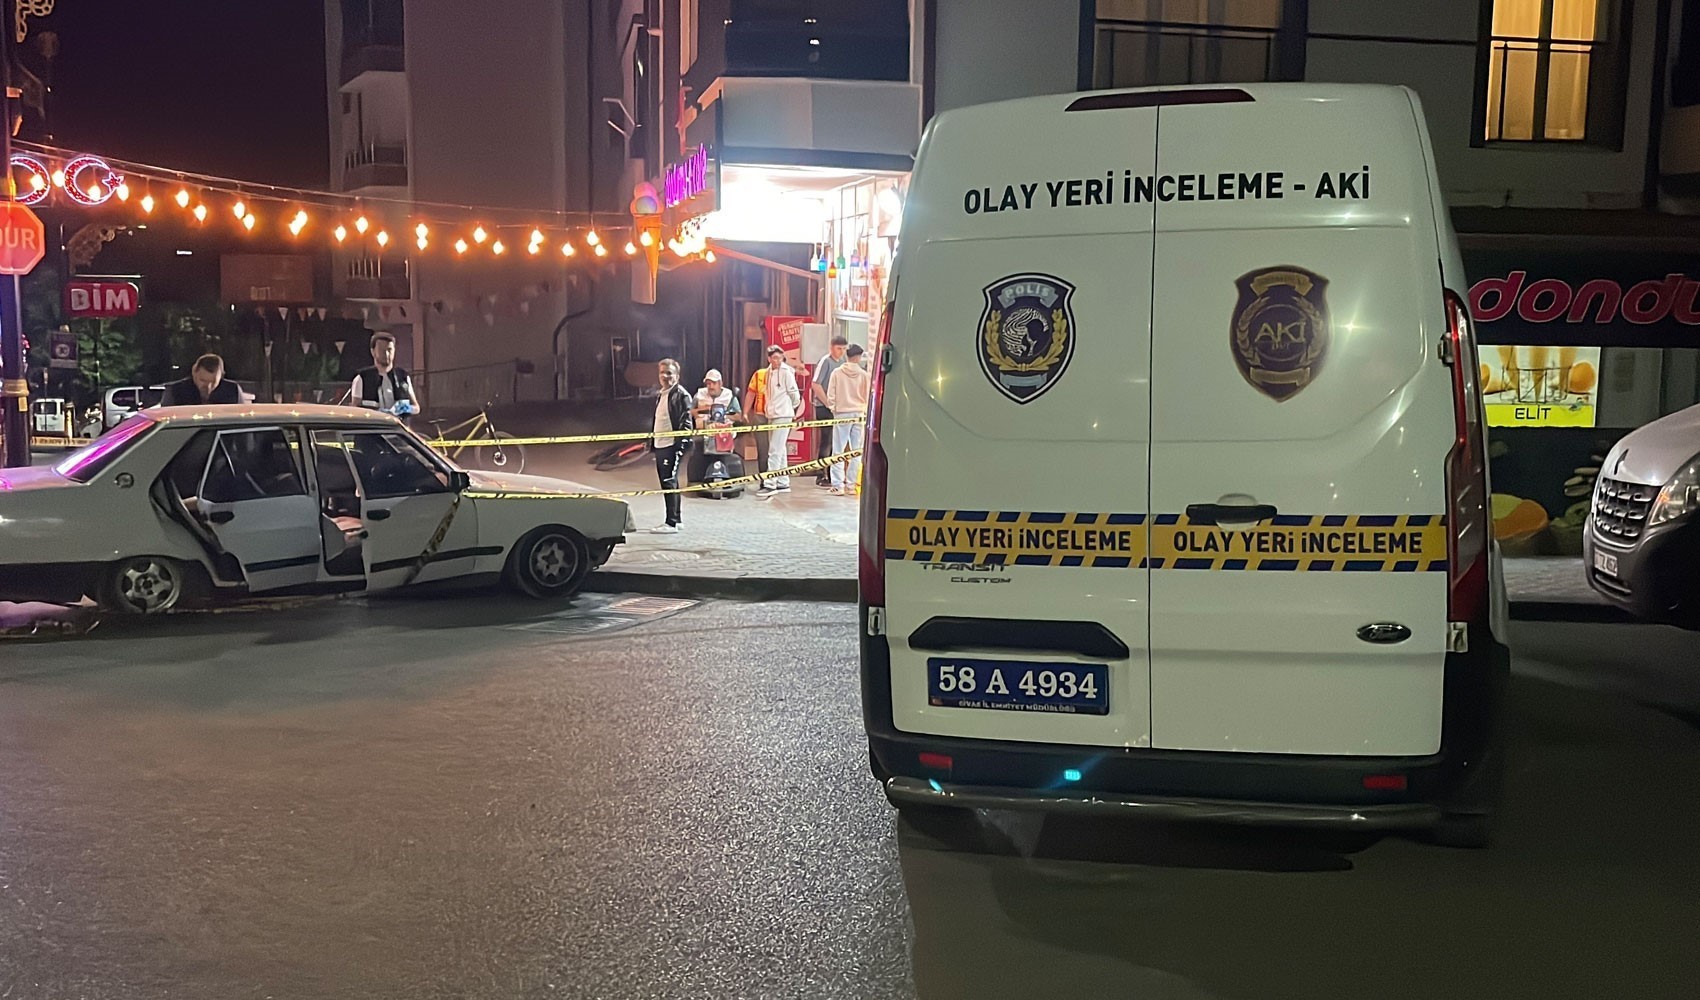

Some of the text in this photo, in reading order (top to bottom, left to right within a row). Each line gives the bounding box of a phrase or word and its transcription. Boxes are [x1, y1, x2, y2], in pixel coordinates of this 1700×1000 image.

[963, 182, 1038, 215] OLAY
[1046, 170, 1114, 208] YERİ
[1123, 169, 1284, 204] İNCELEME
[1314, 165, 1370, 199] AKİ
[0, 227, 36, 250] UR
[71, 283, 130, 311] BİM
[1005, 284, 1050, 299] POLİS
[1515, 404, 1551, 420] ELİT
[908, 526, 960, 549] OLAY
[1173, 530, 1239, 553] OLAY
[920, 563, 1012, 572] TRANSIT
[938, 665, 1098, 699] 58 A 4934
